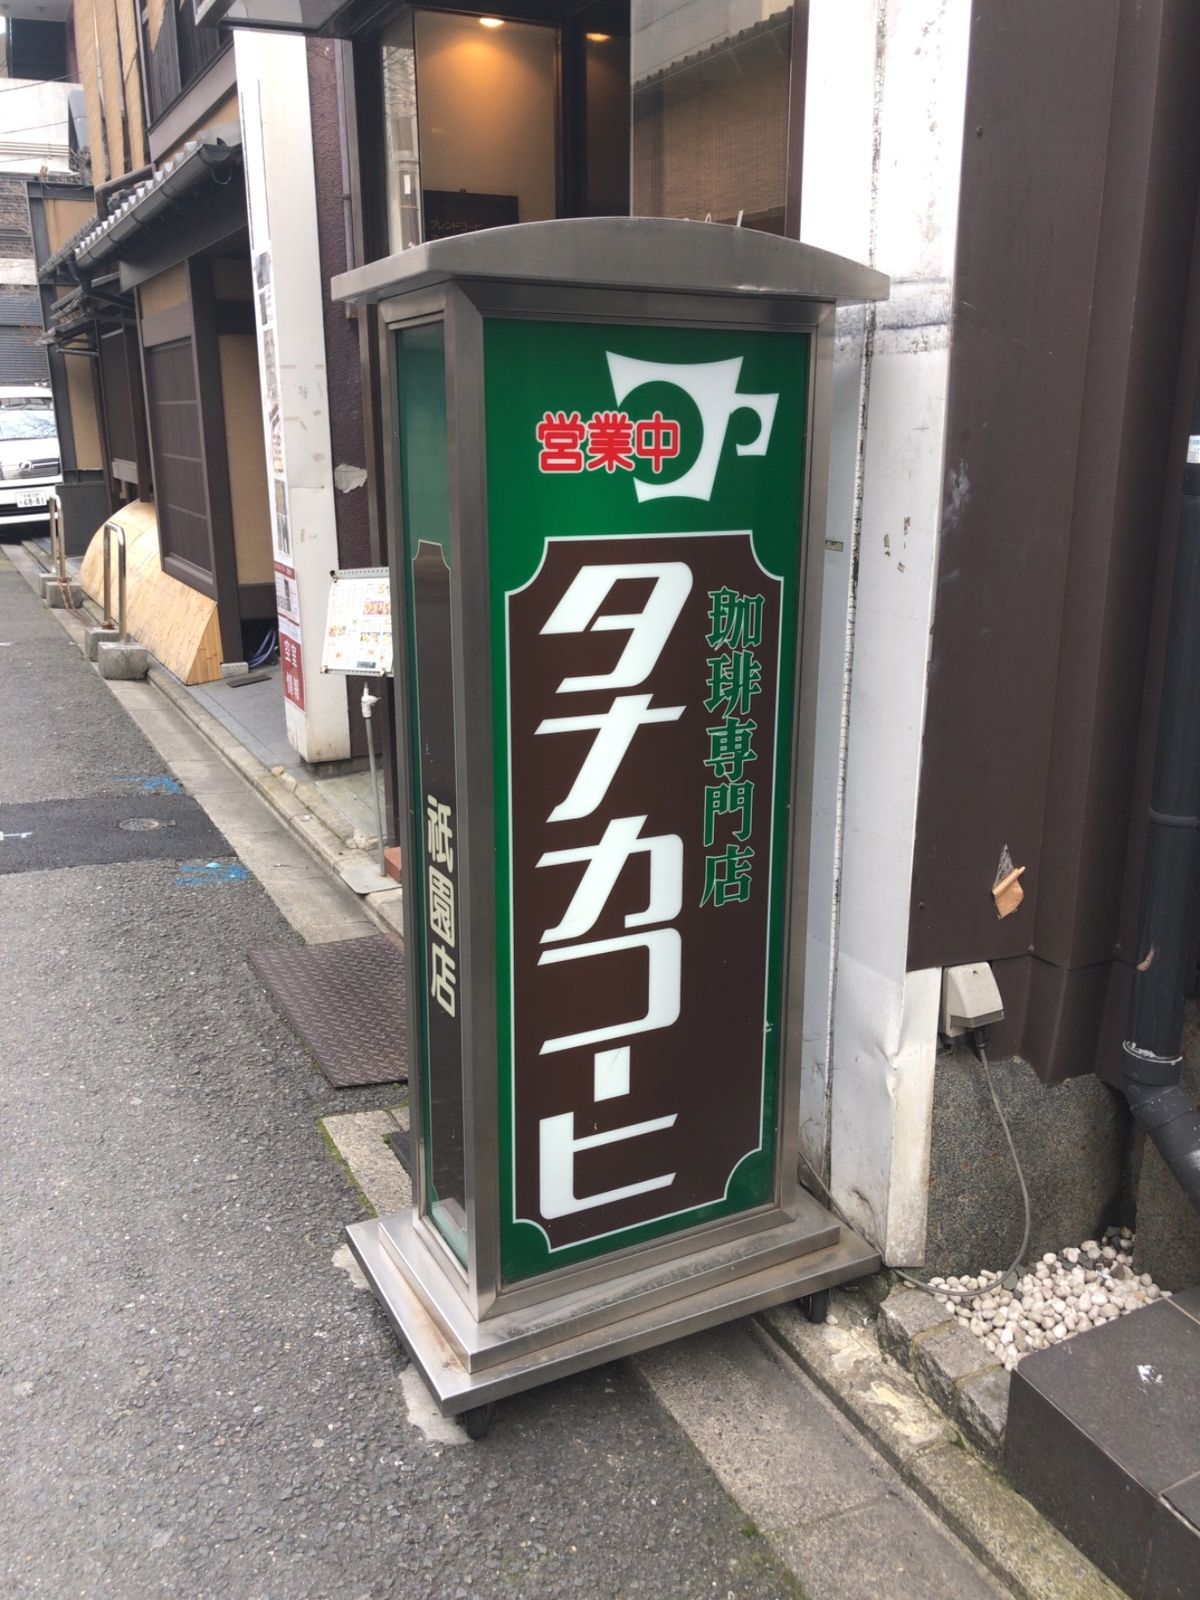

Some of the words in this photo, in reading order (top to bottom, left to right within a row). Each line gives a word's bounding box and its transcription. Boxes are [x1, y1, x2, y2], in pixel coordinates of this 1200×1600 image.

[536, 411, 680, 474] 営業中
[700, 585, 766, 908] 珈琲専門店
[427, 794, 457, 1018] 祇園店
[534, 561, 694, 1221] タナカコーヒ
